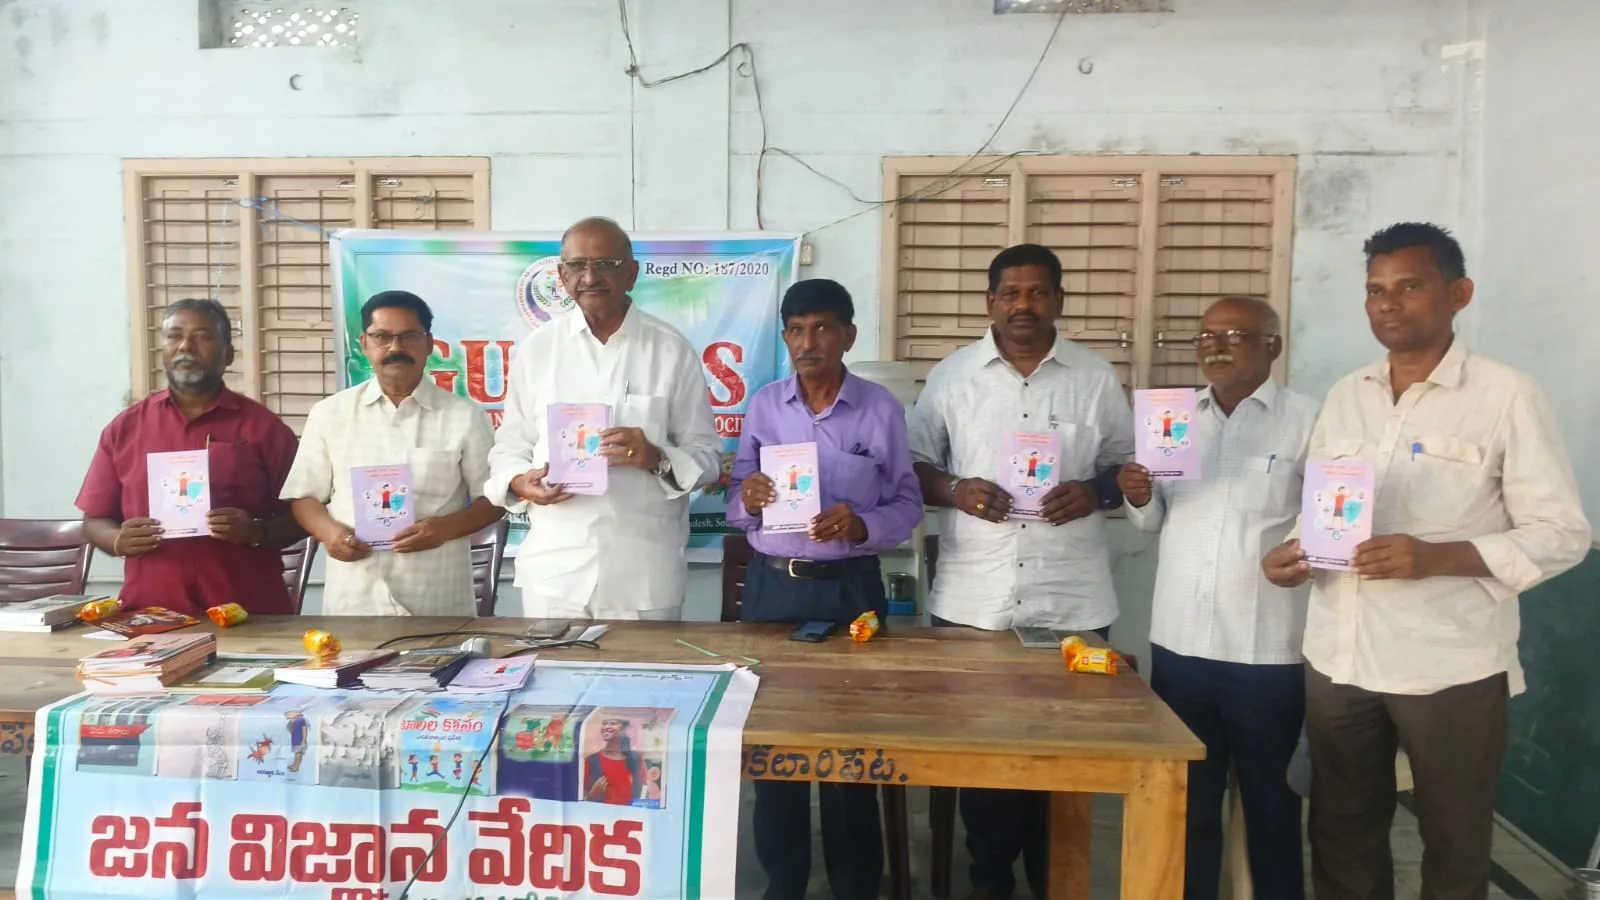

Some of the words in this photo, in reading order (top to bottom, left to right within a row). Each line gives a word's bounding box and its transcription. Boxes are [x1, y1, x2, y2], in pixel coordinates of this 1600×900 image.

[645, 262, 677, 277] Regd
[681, 262, 709, 275] NO:
[713, 262, 769, 276] 187/2020
[89, 801, 209, 879] జన
[468, 797, 643, 896] వేదిక
